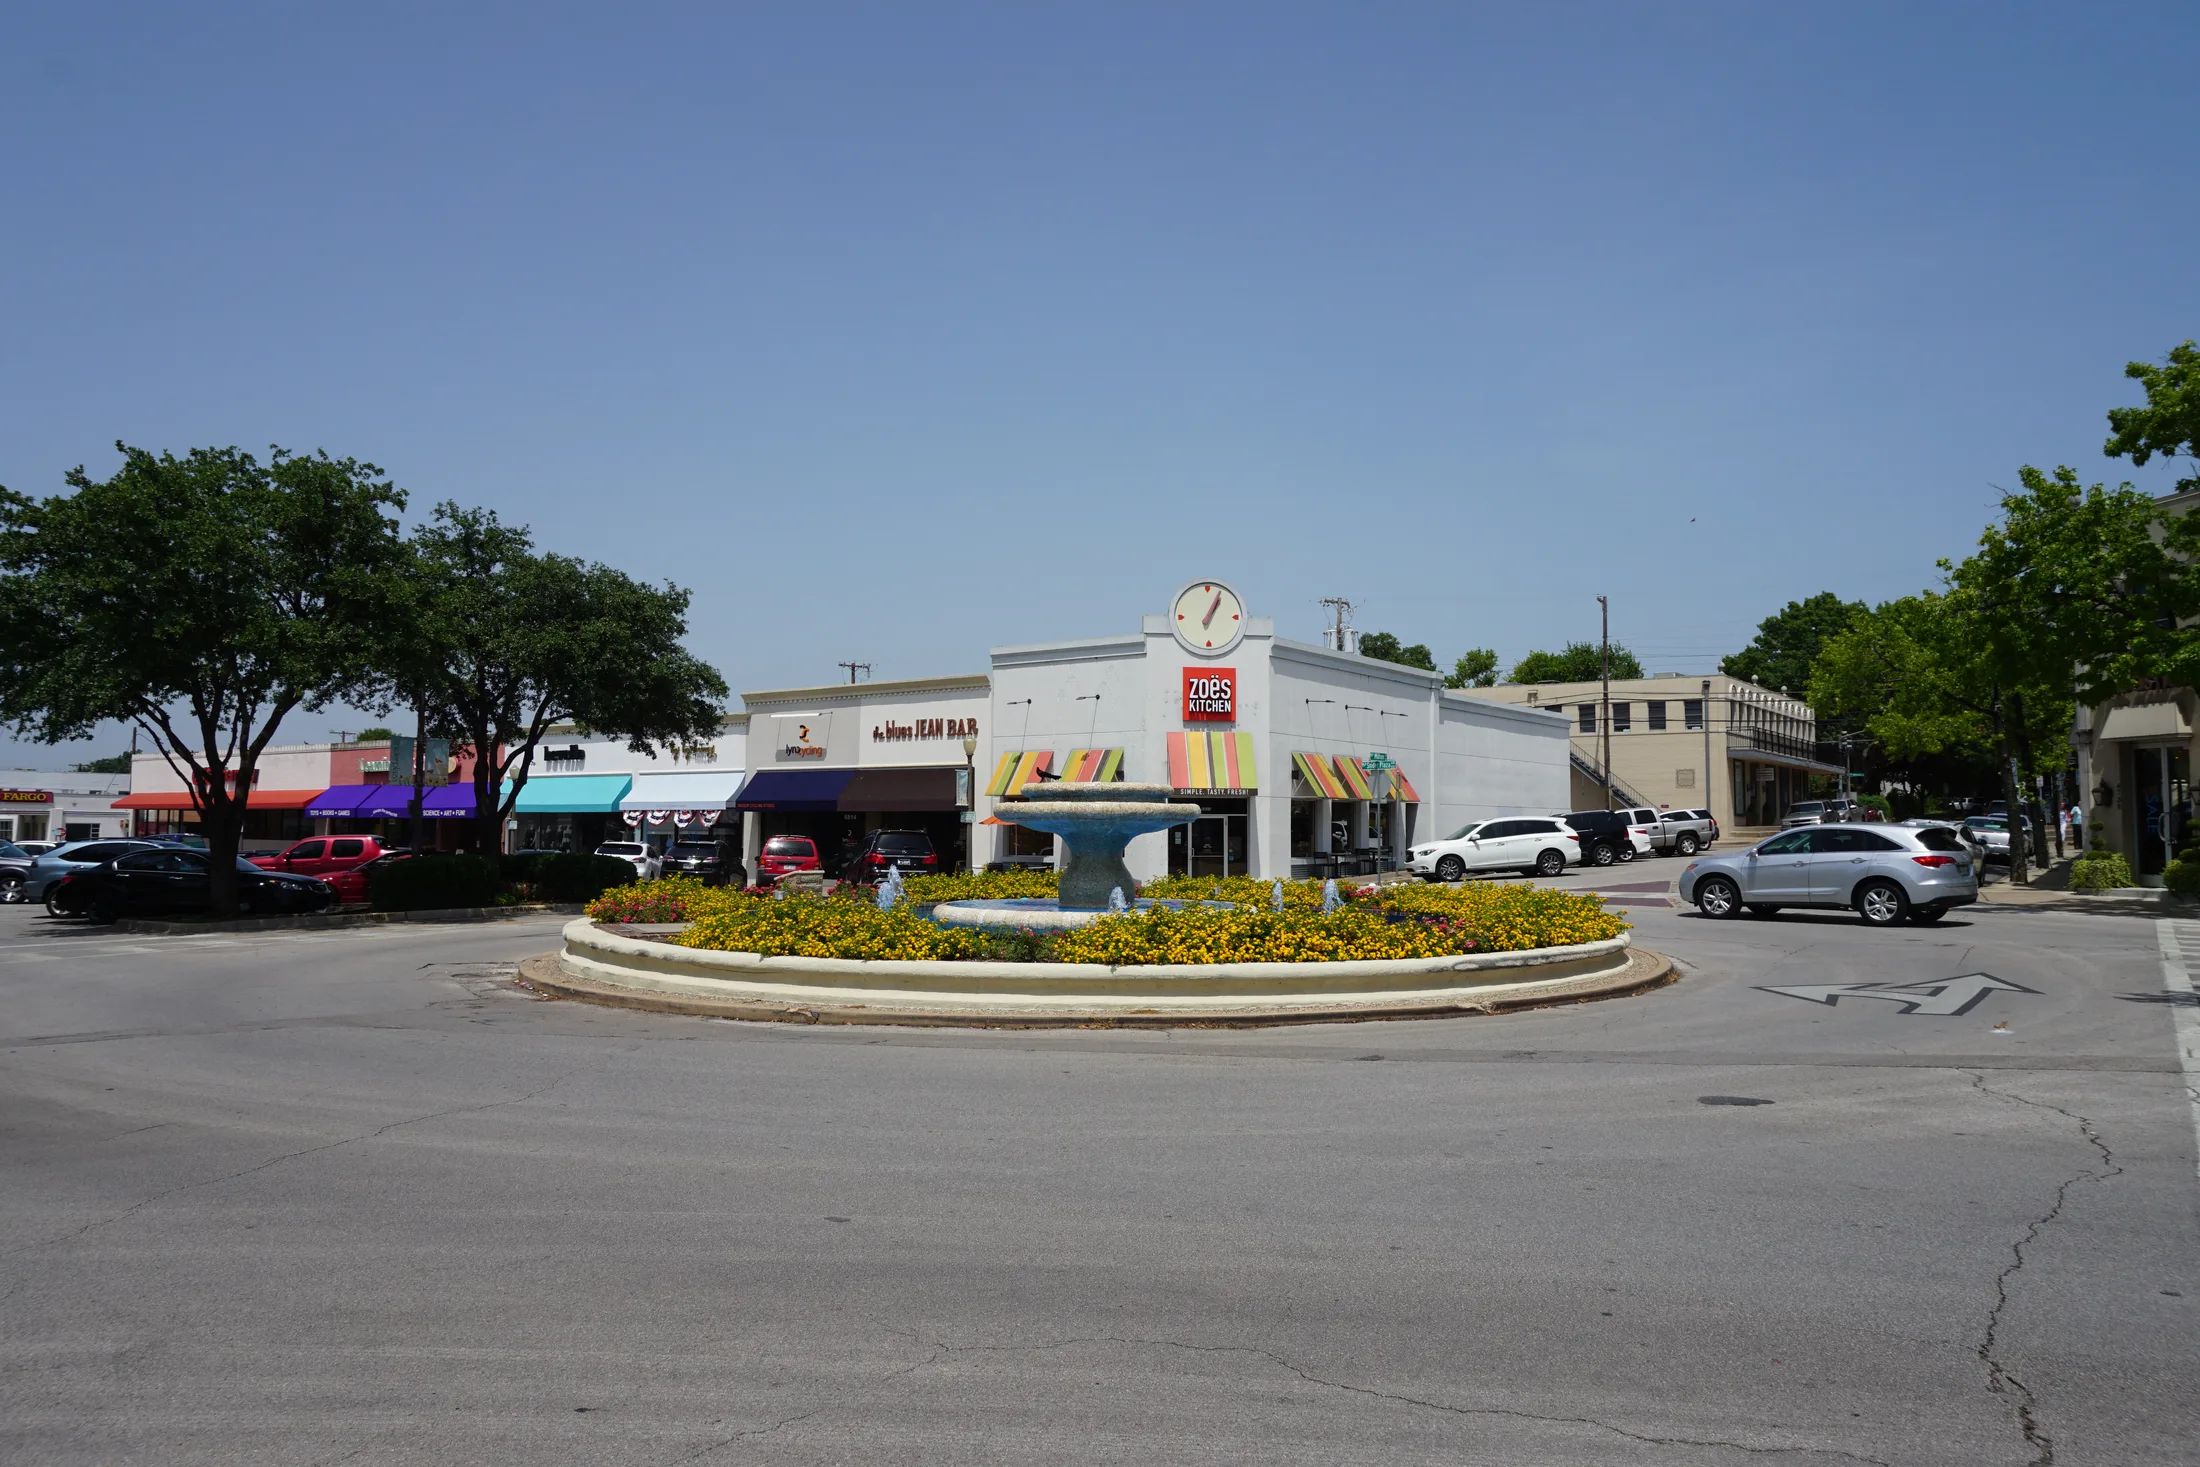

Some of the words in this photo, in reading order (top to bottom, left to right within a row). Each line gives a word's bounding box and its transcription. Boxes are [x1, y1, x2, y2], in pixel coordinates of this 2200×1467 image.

[1189, 699, 1231, 712] KITCHEN
[885, 719, 913, 739] blues
[914, 718, 943, 737] JEAN
[947, 718, 979, 737] BAR
[357, 756, 391, 772] Learnin
[3, 792, 47, 801] FARGO
[423, 809, 440, 817] SCIENCE
[443, 809, 452, 817] ART
